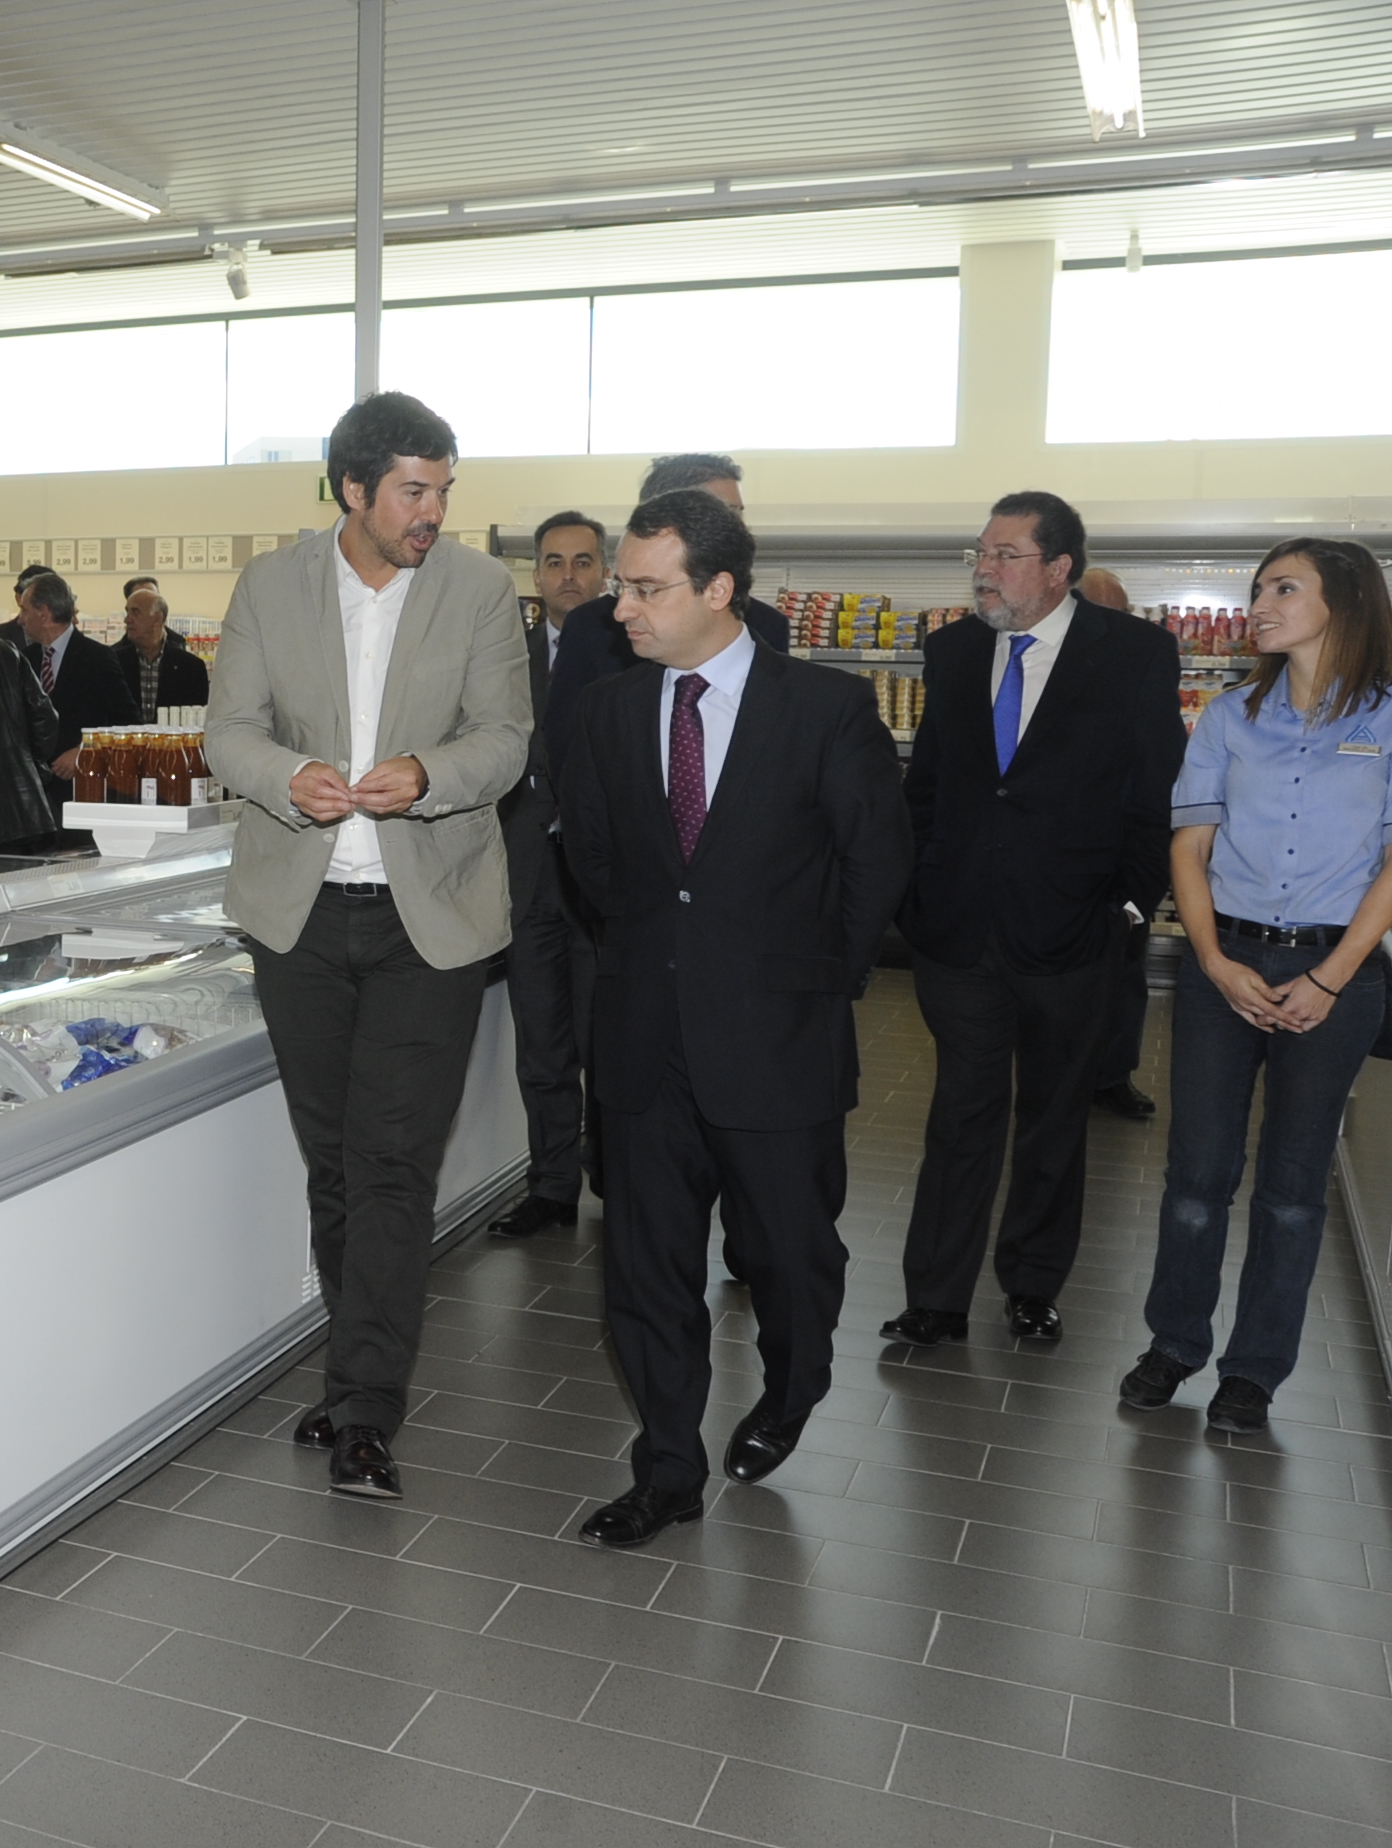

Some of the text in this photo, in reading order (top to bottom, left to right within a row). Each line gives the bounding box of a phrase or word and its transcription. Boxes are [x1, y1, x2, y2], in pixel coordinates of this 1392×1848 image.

[56, 558, 71, 566] 2,99
[83, 558, 97, 566] 2,99
[158, 556, 174, 564] 2,99
[188, 555, 203, 564] 1,99
[212, 555, 227, 564] 1,99
